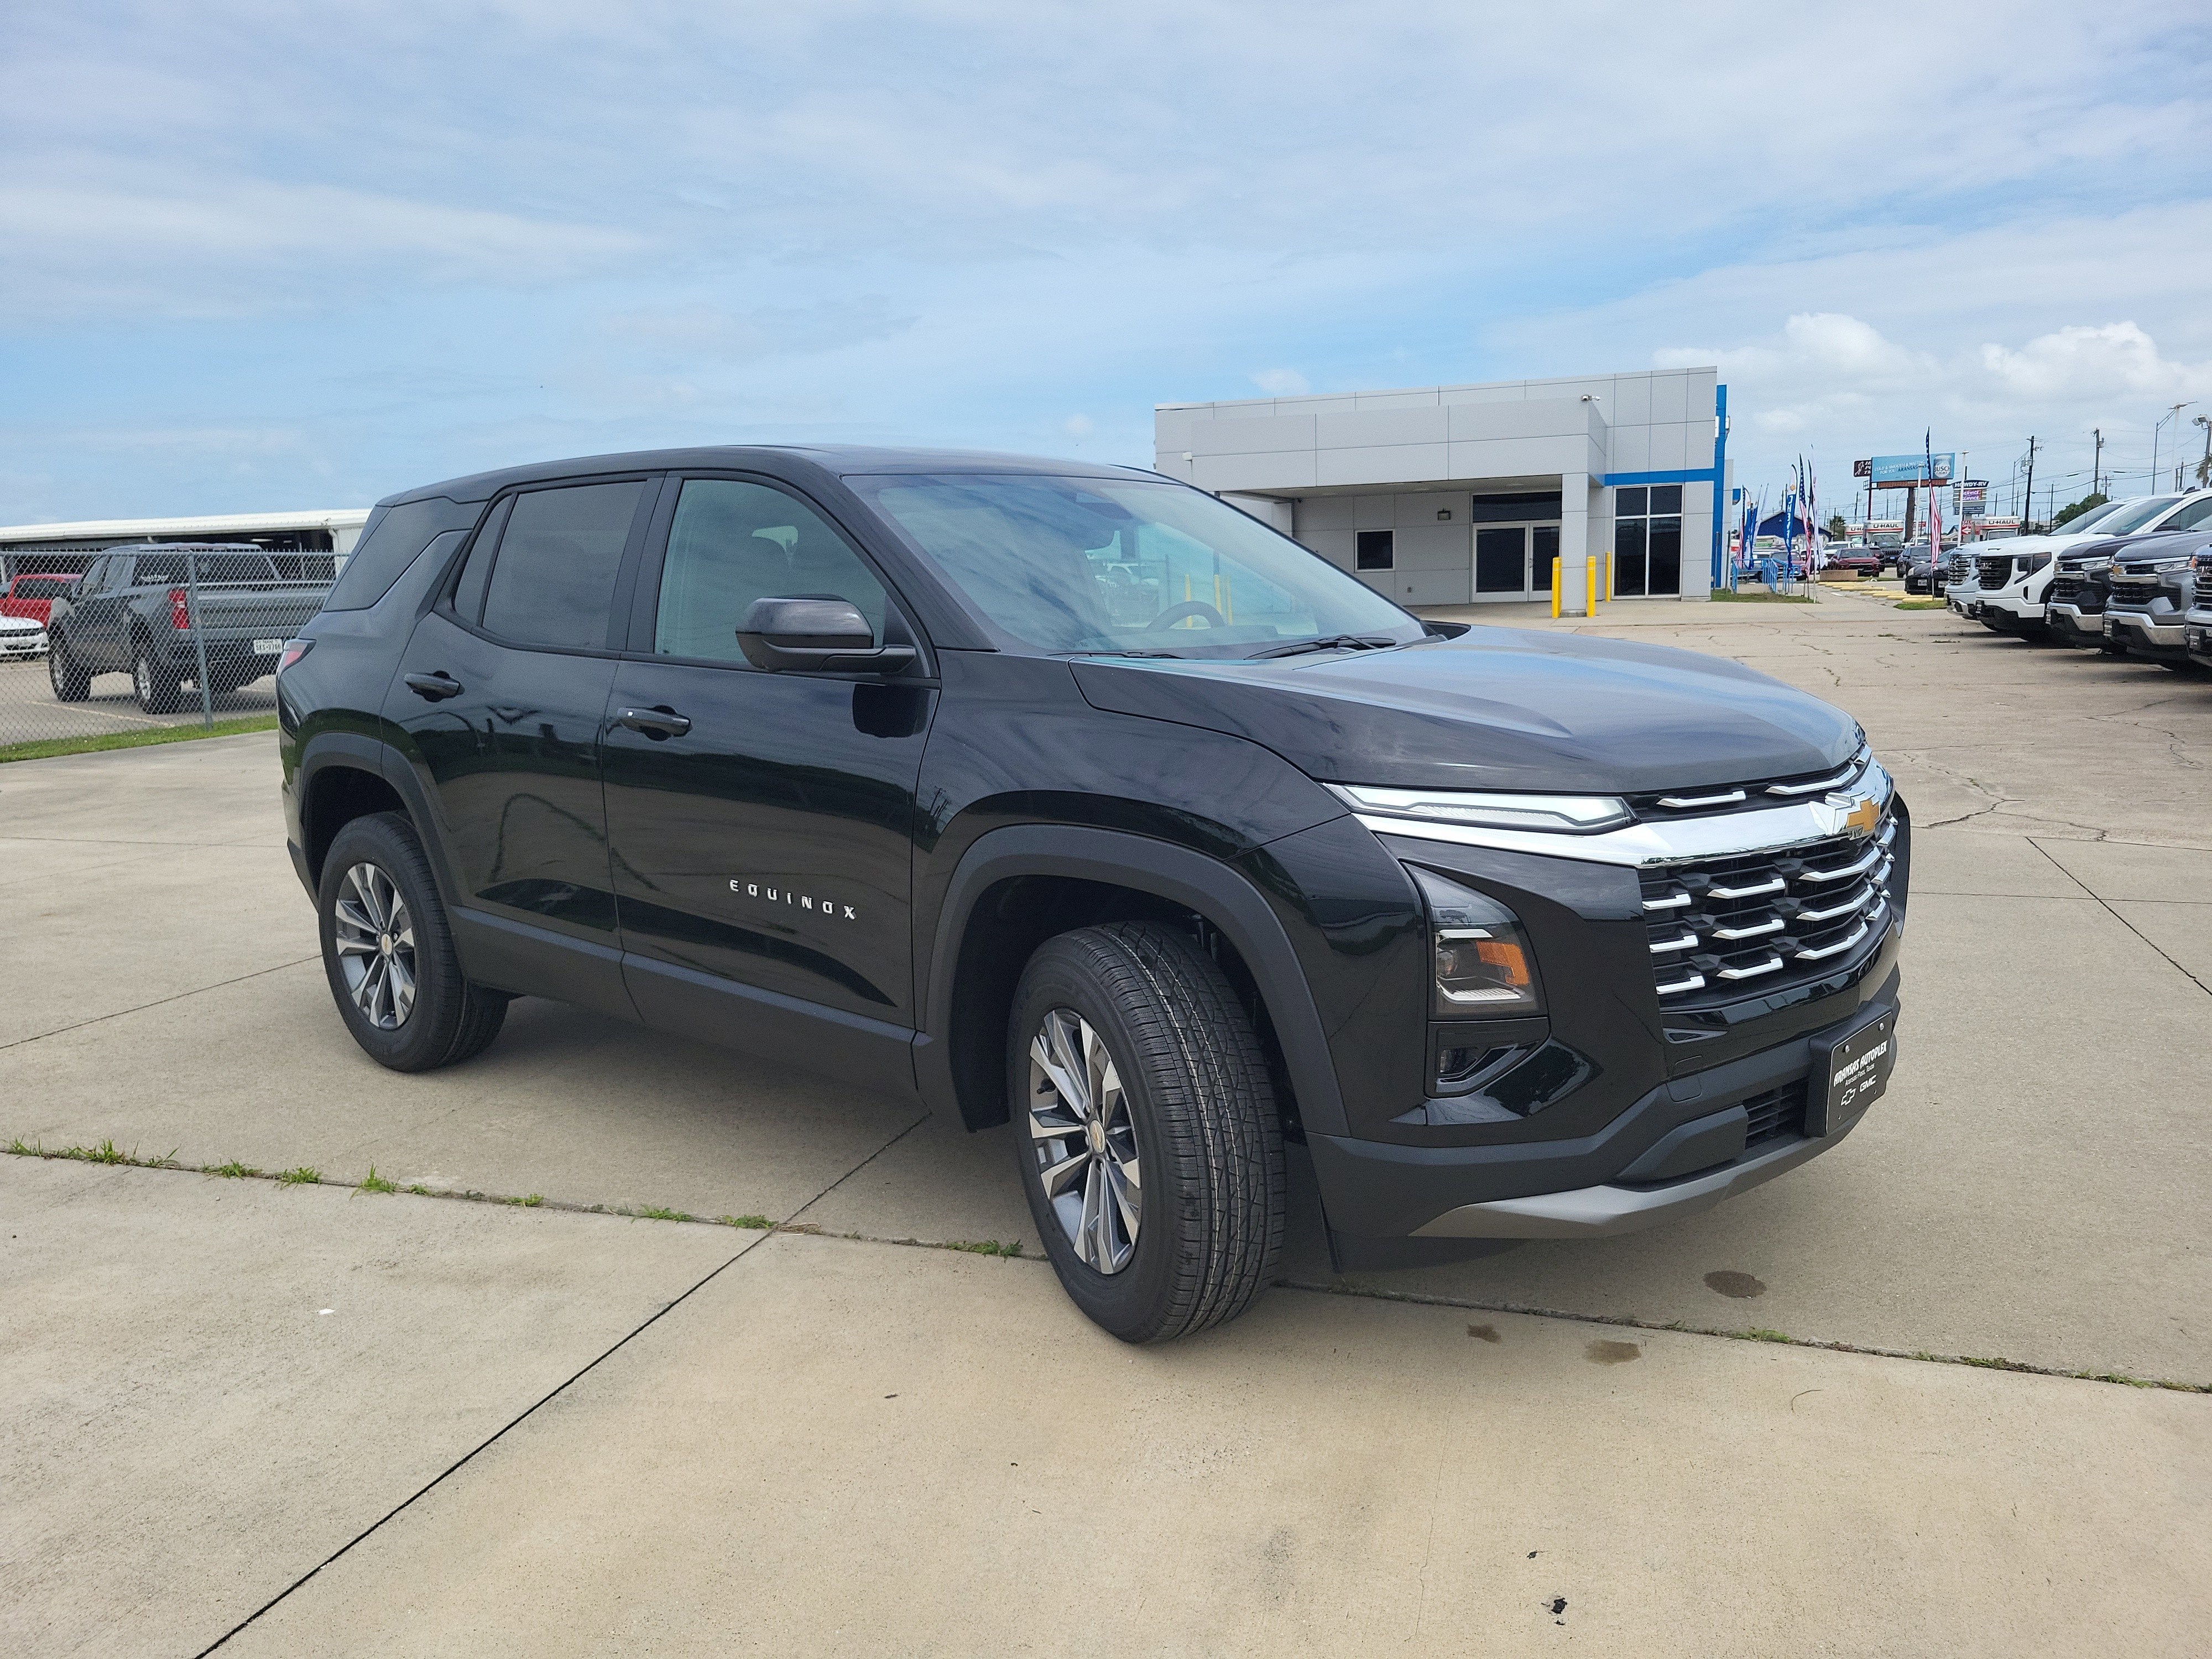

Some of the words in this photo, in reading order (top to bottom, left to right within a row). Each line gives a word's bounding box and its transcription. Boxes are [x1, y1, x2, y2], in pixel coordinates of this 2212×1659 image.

[729, 879, 856, 920] EQUINOX
[1833, 1058, 1860, 1087] ARANSAS
[1860, 1040, 1887, 1070] AUTOPLEX
[1844, 1074, 1858, 1087] Aransas
[1859, 1074, 1876, 1092] GMC
